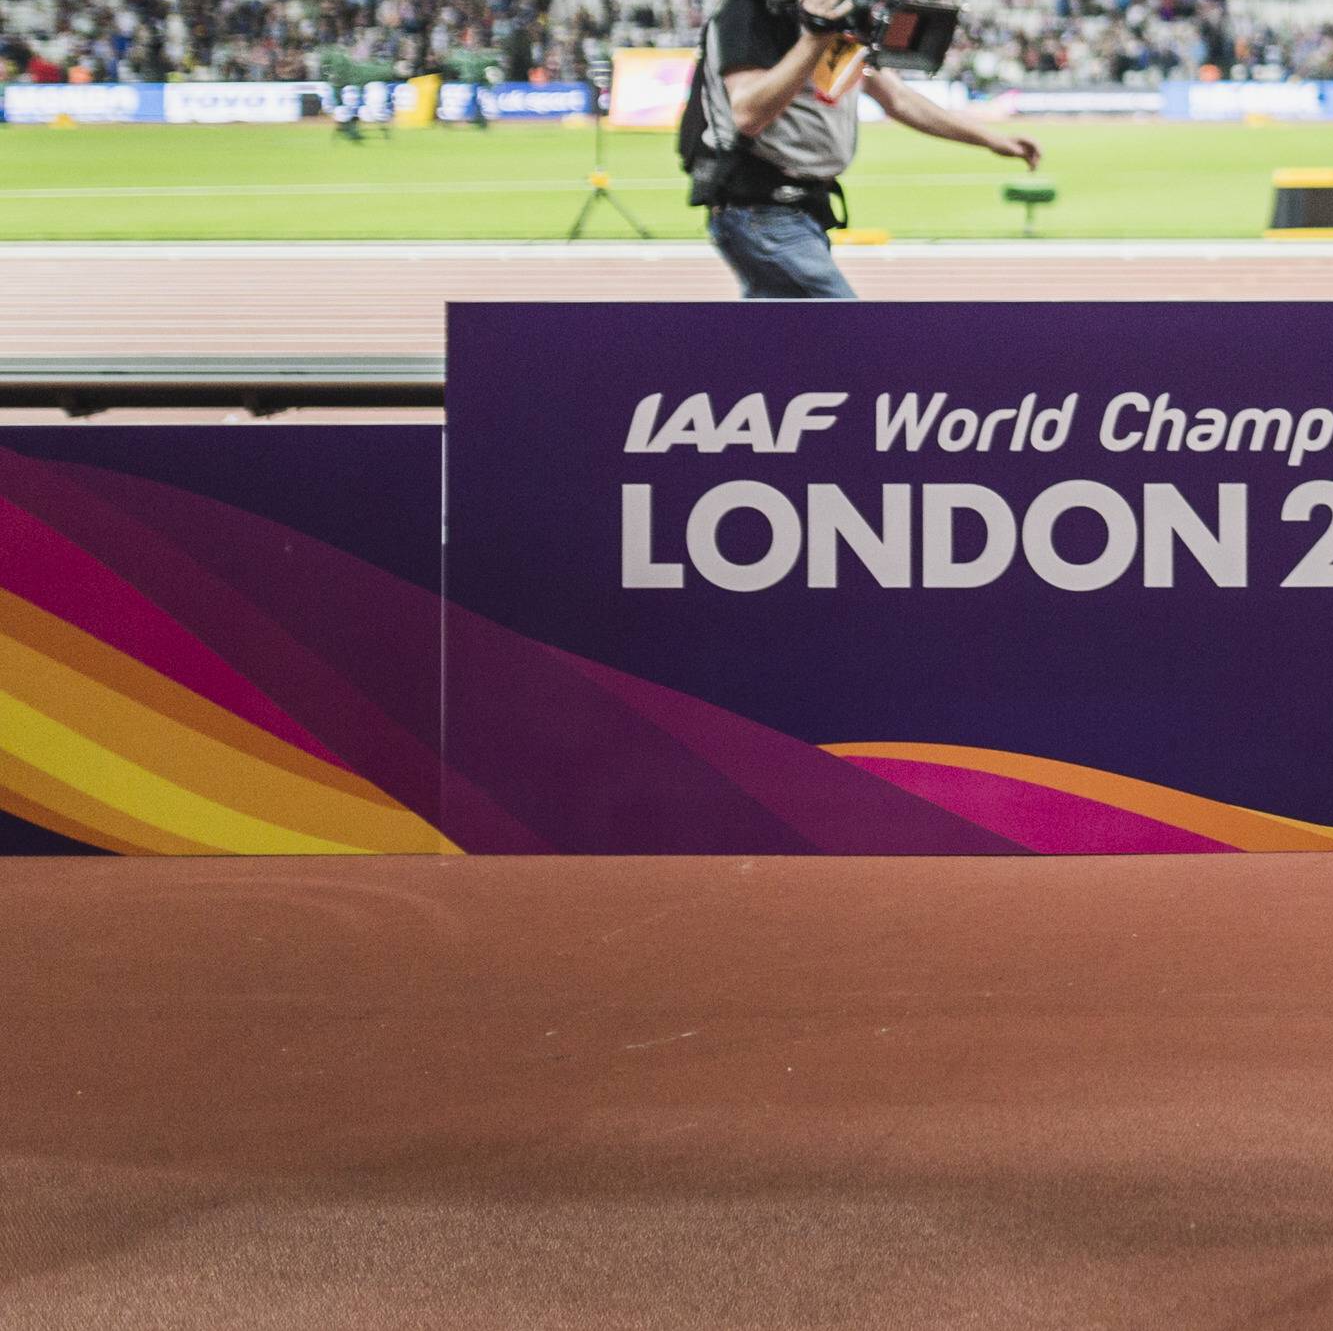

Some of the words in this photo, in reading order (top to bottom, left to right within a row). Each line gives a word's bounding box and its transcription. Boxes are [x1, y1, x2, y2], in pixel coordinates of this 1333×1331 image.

[623, 392, 849, 453] IAAF
[875, 392, 1079, 453] World
[621, 479, 1248, 592] LONDON
